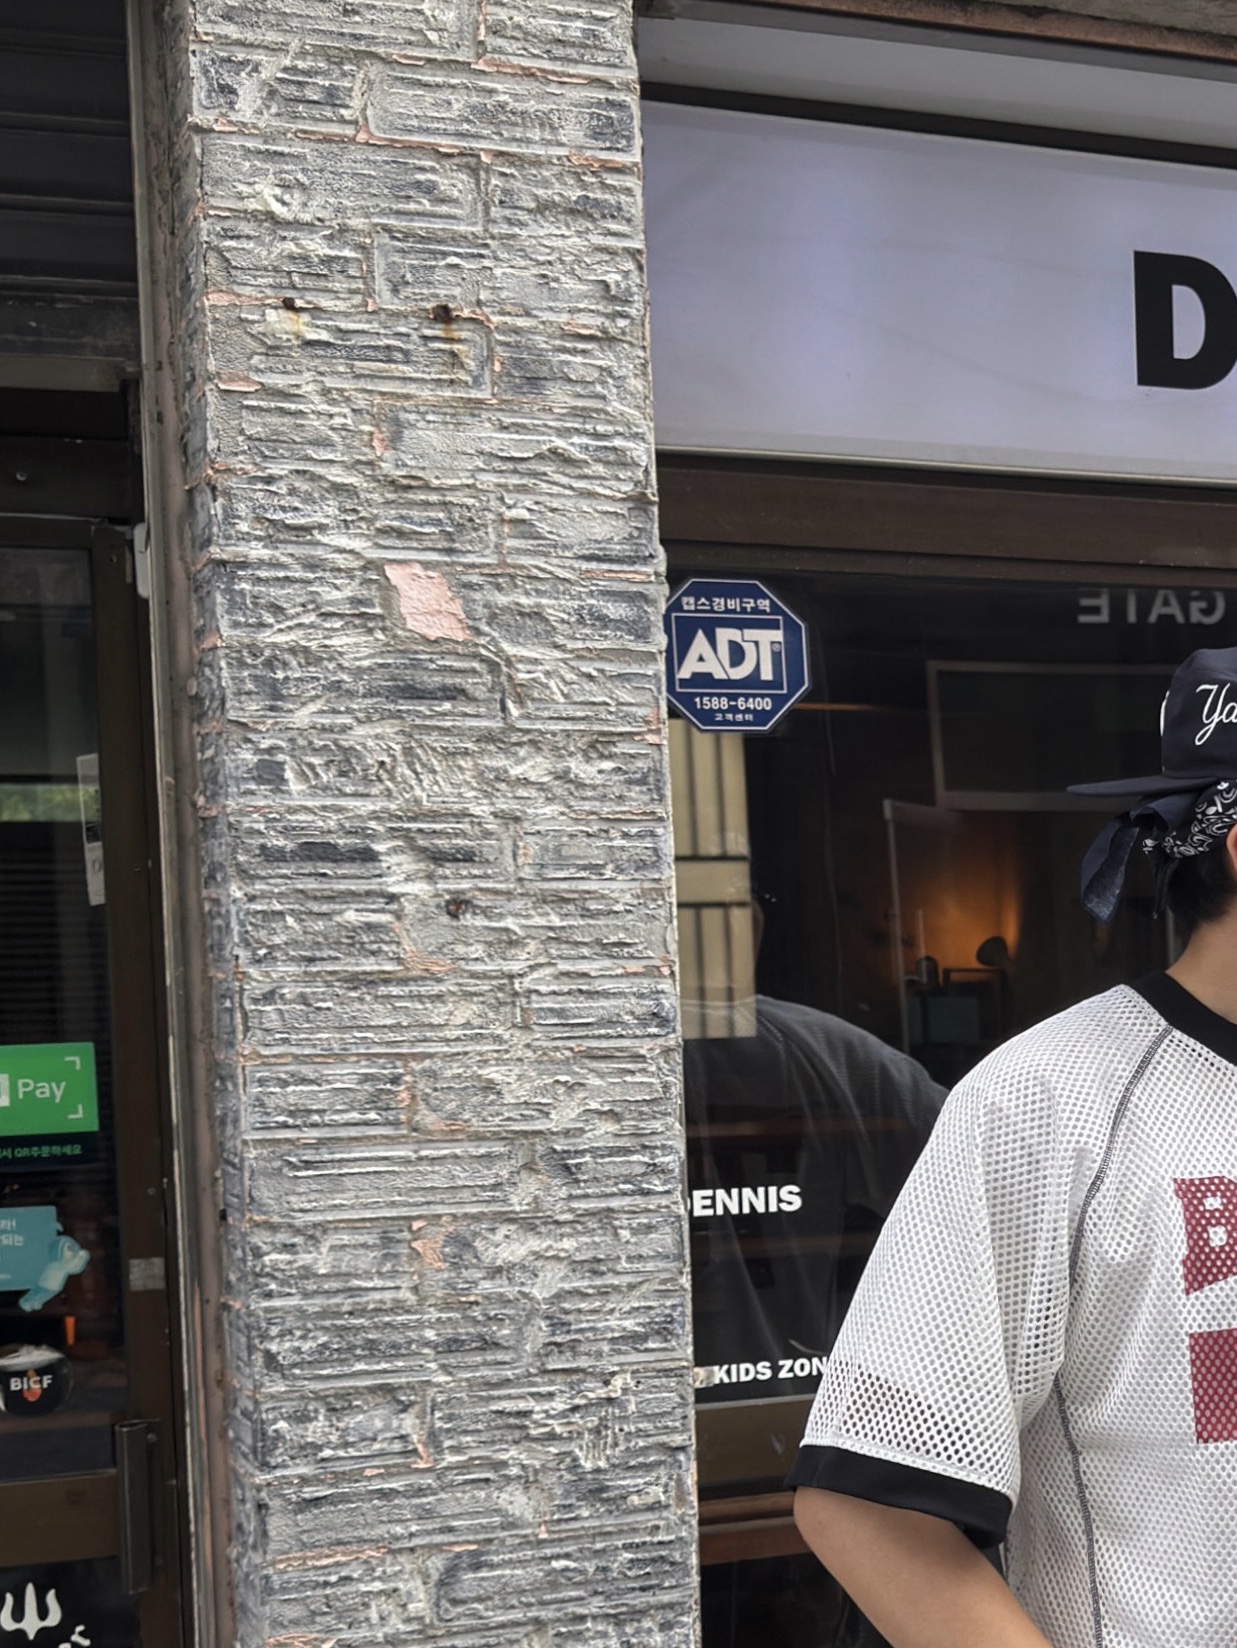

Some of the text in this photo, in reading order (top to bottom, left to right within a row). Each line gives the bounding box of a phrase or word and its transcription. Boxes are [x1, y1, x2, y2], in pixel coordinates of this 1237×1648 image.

[681, 596, 771, 613] 캡스경비구역
[677, 627, 783, 681] ADT
[694, 697, 772, 711] 1588-6400
[17, 1078, 67, 1104] Pay
[688, 1185, 802, 1217] ENNIS
[713, 1361, 772, 1385] KIDS
